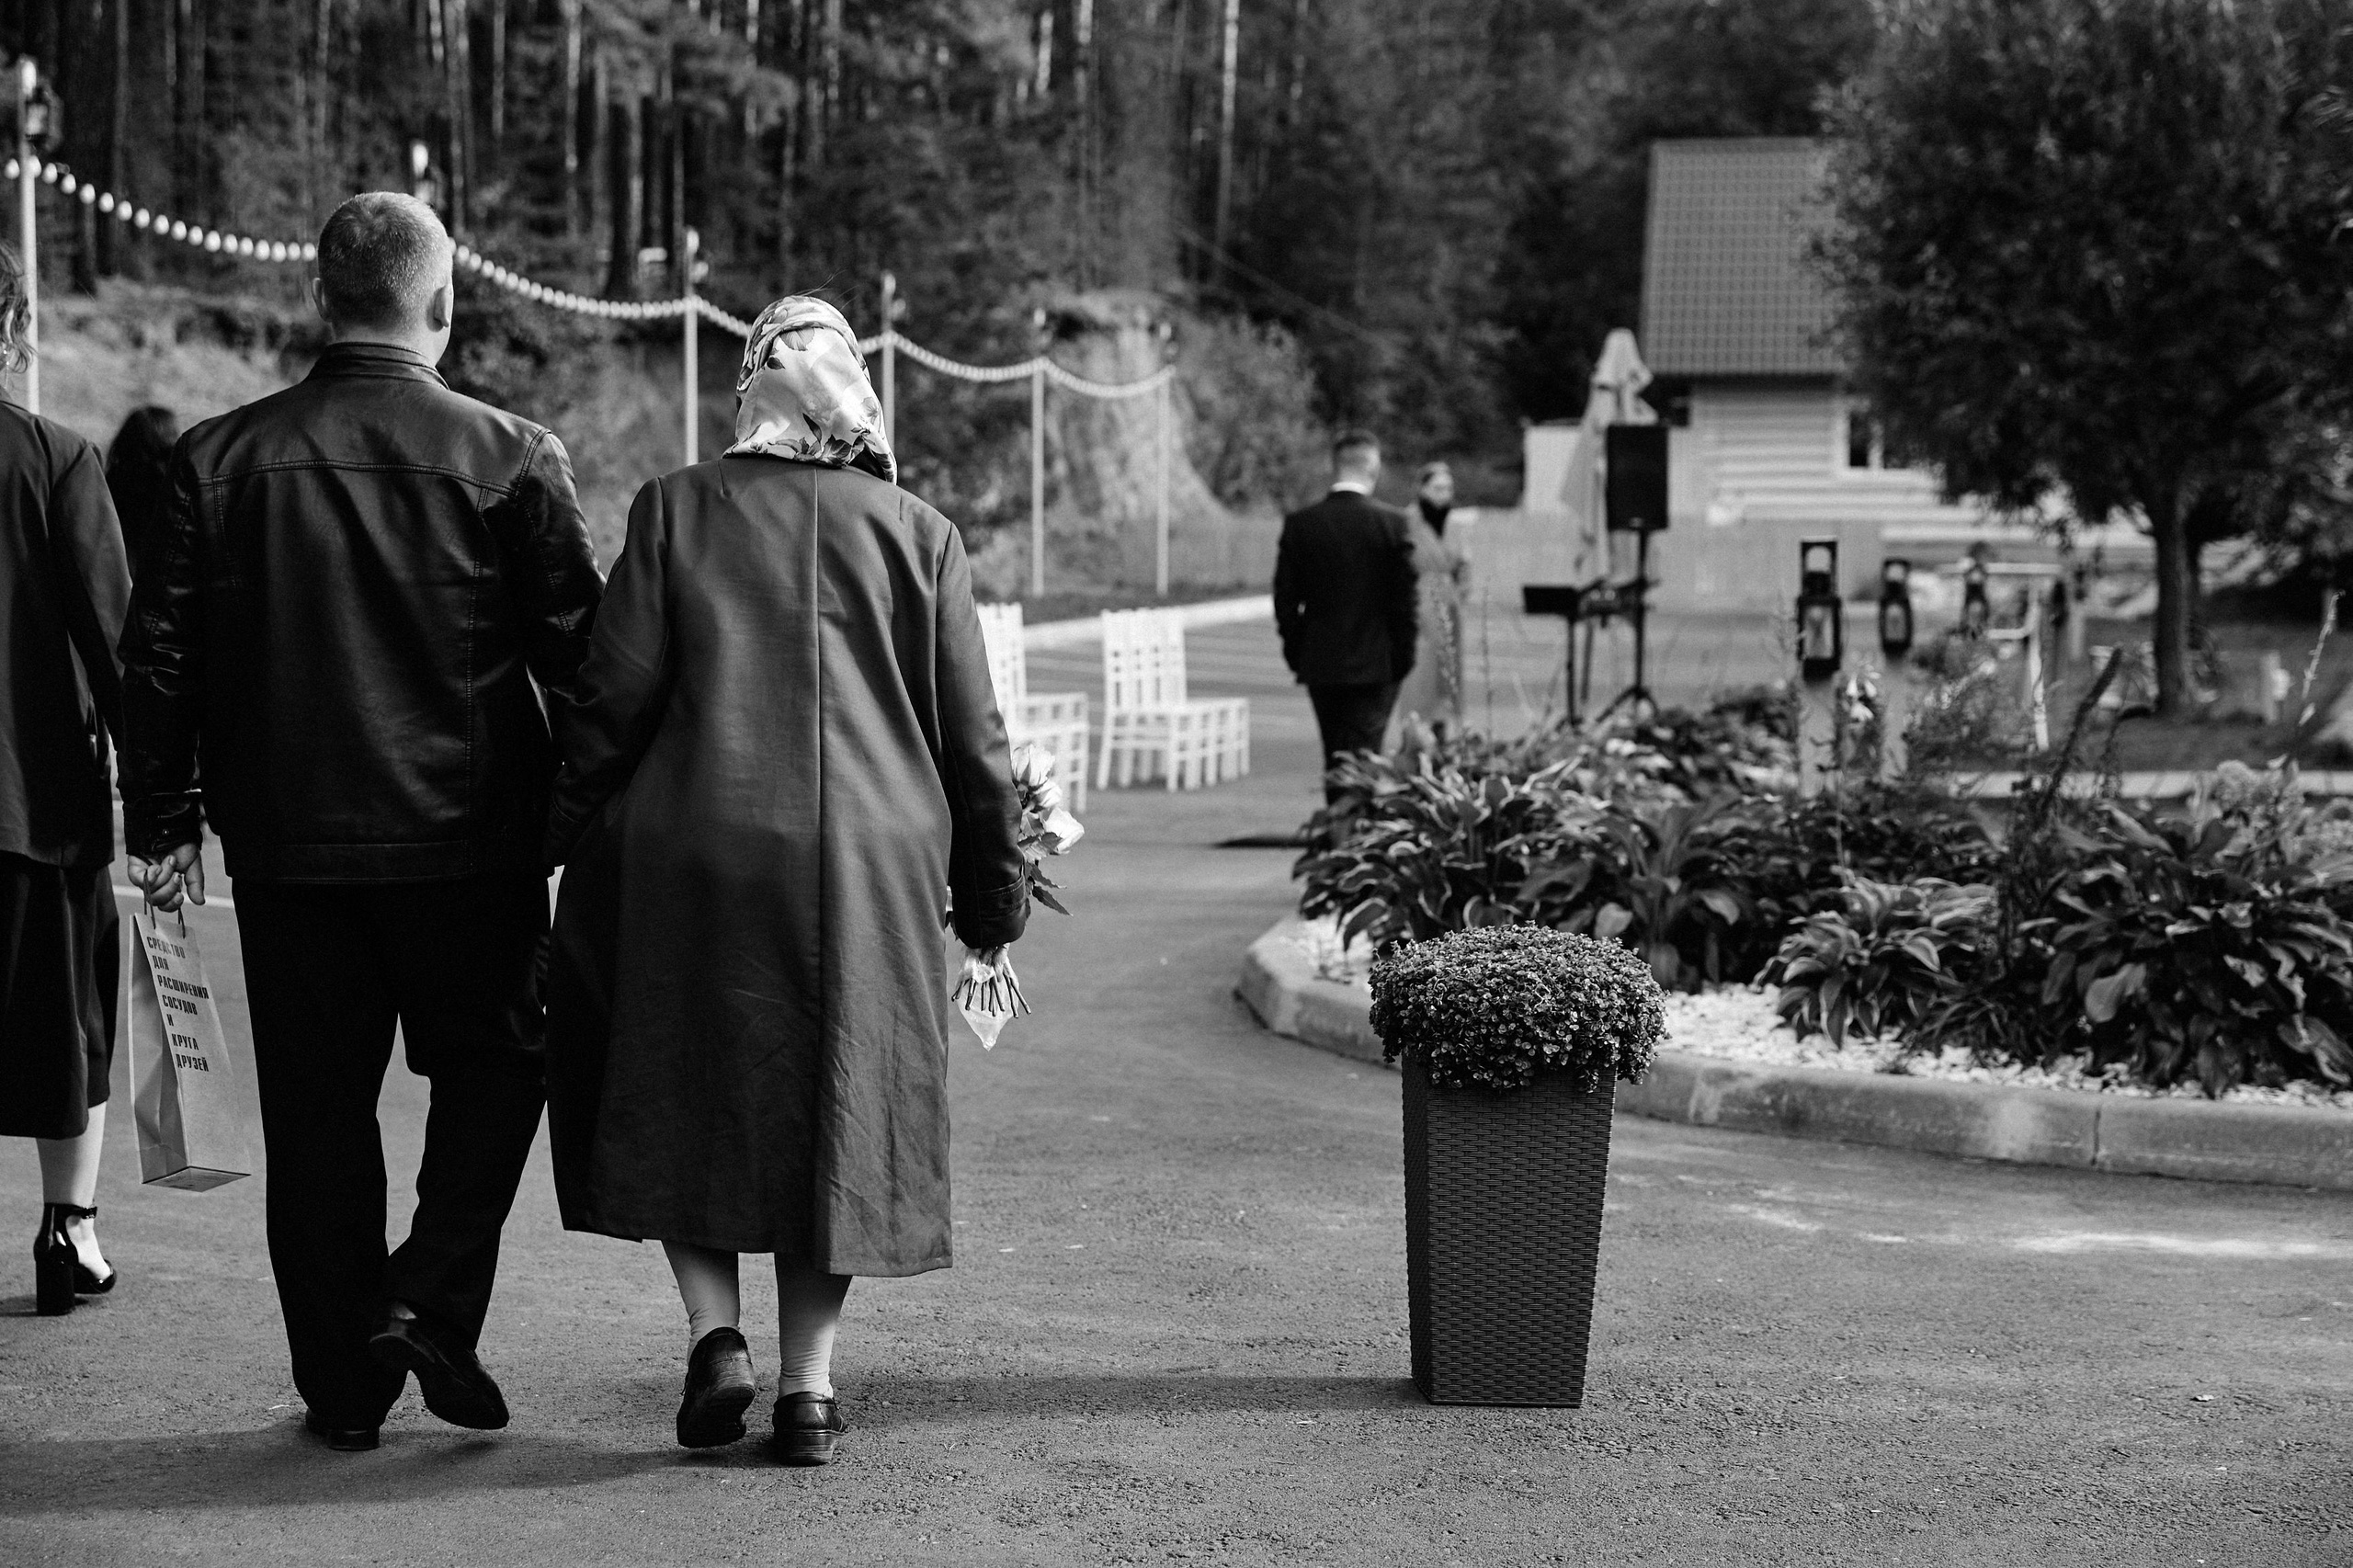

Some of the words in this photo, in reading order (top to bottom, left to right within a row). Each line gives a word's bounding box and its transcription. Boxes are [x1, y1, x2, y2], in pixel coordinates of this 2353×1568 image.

[147, 936, 186, 959] СРЕДСТВО
[152, 955, 169, 971] ДЛЯ
[157, 974, 210, 999] РАСШИРЕНИЯ
[162, 994, 198, 1015] СОСУДОВ
[166, 1014, 174, 1027] И
[171, 1033, 199, 1051] КРУГА
[176, 1053, 209, 1073] ДРУЗЕЙ
